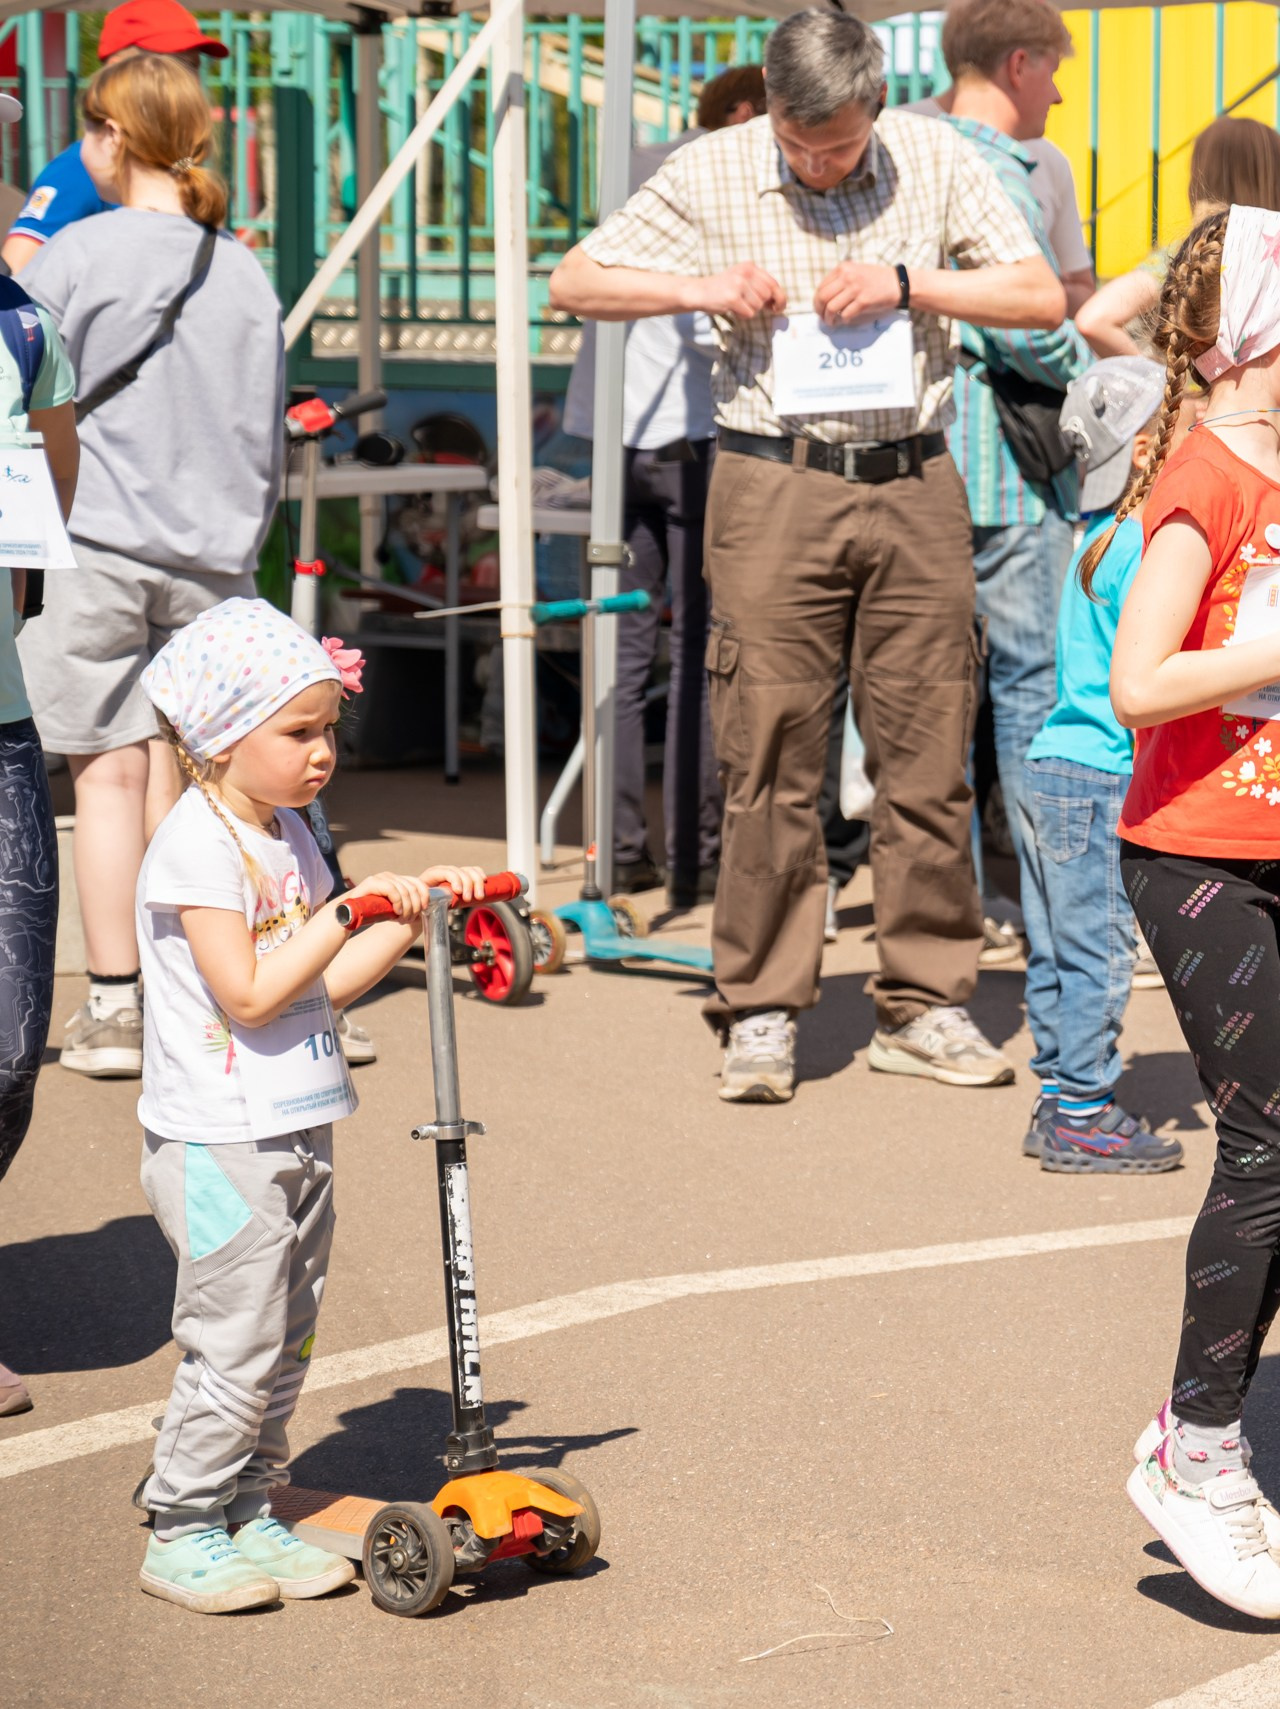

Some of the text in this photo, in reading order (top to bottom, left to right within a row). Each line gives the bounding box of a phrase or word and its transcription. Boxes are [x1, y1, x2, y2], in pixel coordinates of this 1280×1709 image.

[819, 350, 864, 370] 206
[1178, 879, 1213, 916] FOREVER
[1189, 881, 1224, 920] UNICORN
[1172, 948, 1193, 982] FOREVER
[1180, 951, 1205, 988] UNICORN
[1228, 943, 1257, 985] UNICORN
[1241, 945, 1266, 986] FOREVER
[1213, 1011, 1243, 1048] FOREVER
[1224, 1012, 1255, 1052] UNICORN
[1195, 1264, 1240, 1290] UNICORN
[1203, 1328, 1244, 1357] UNICORN
